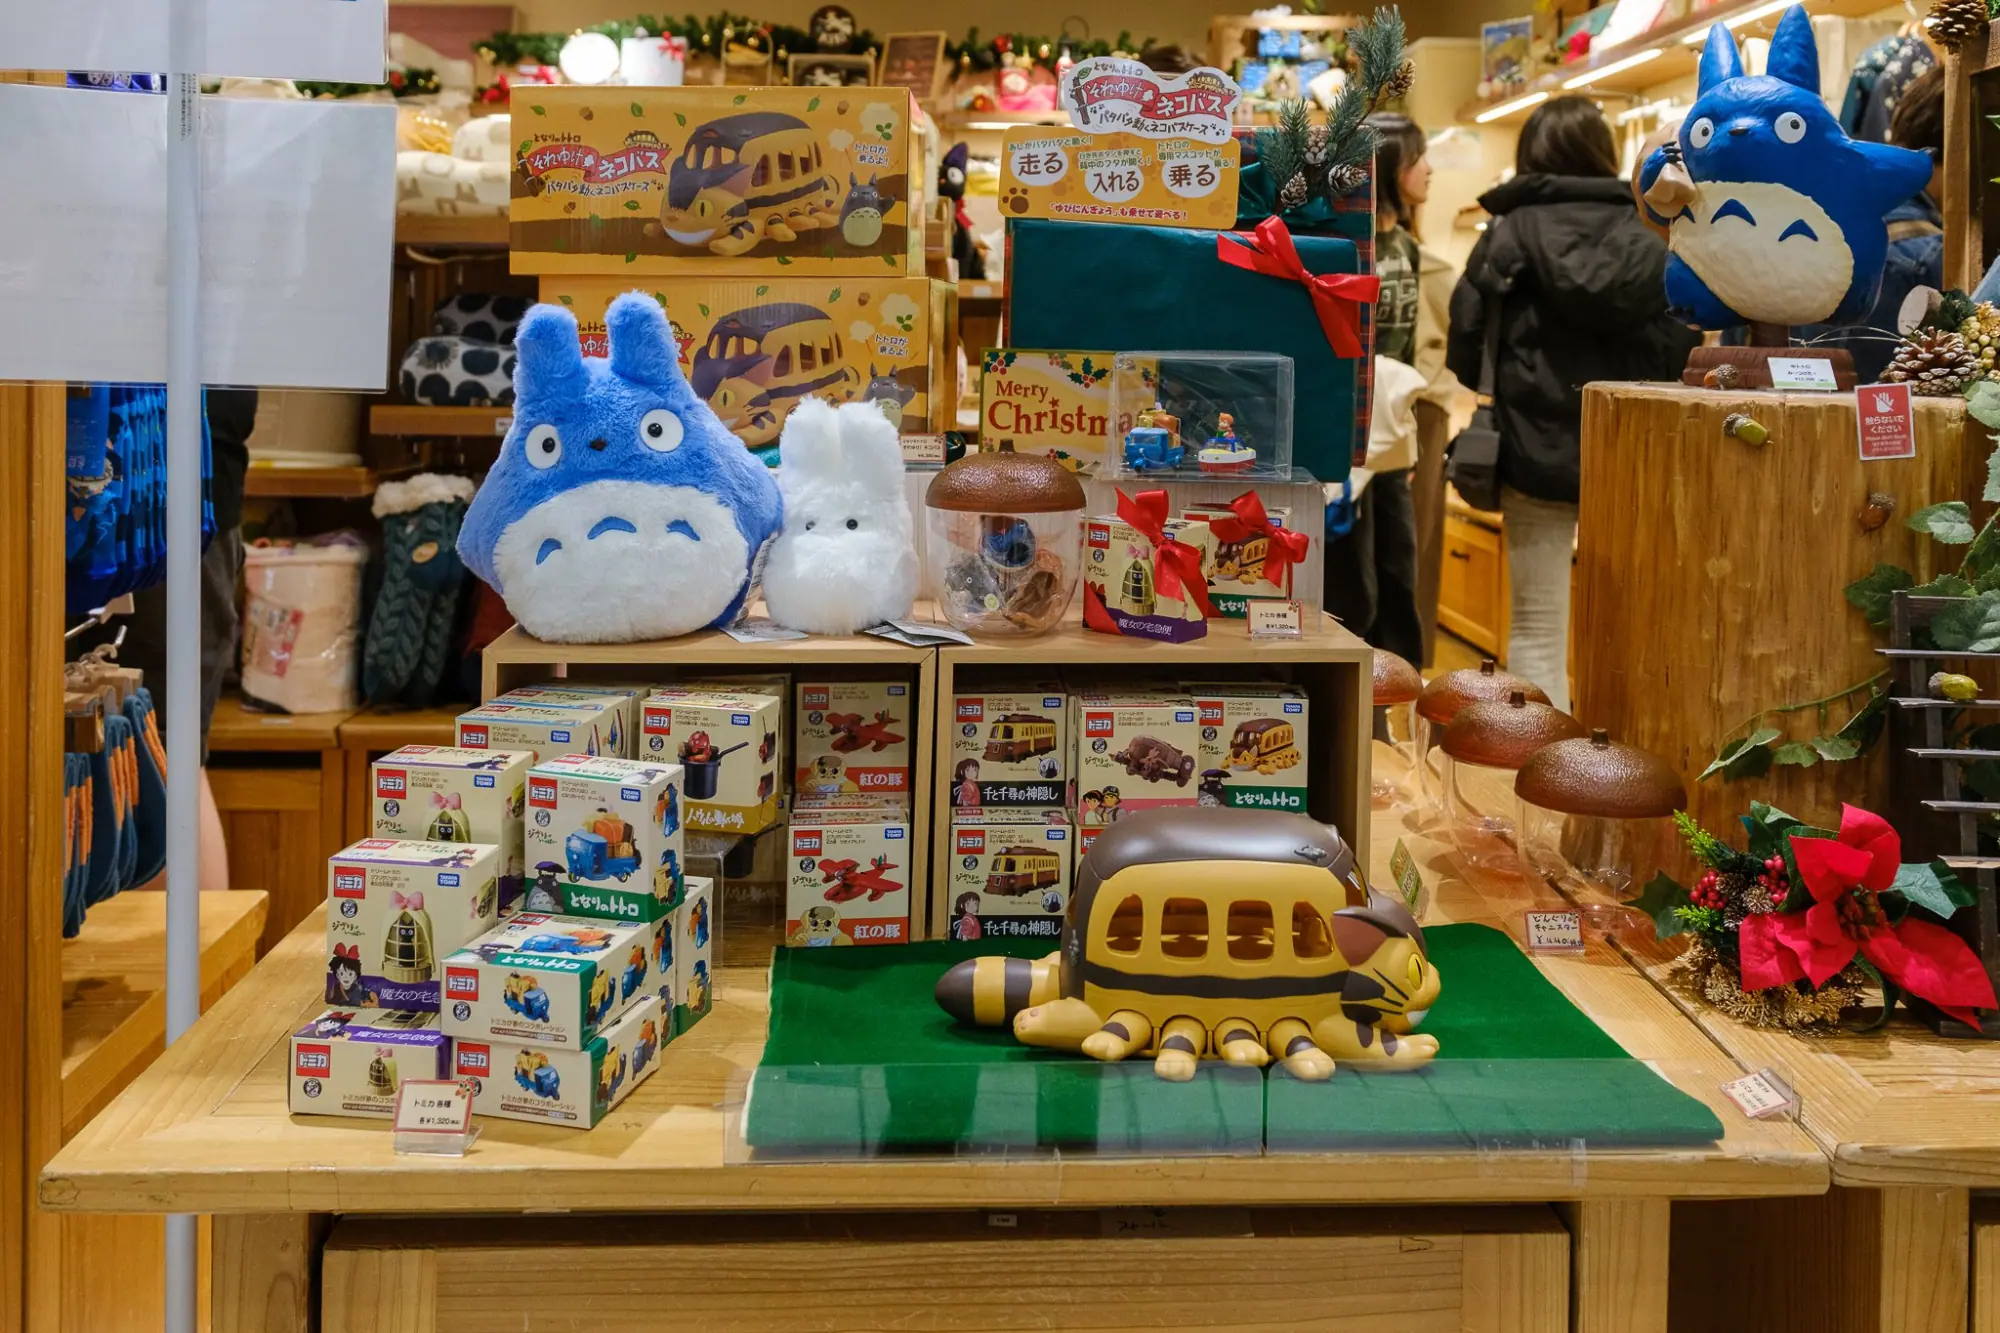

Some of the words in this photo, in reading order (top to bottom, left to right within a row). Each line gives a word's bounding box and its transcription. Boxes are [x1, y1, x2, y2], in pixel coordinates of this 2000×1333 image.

[1094, 61, 1144, 76] となりのトトロ
[1157, 92, 1223, 117] ネコバス
[599, 150, 659, 179] ネコバス
[1018, 152, 1063, 177] 走る
[1092, 170, 1140, 194] 入れる
[1168, 164, 1216, 188] 乗る
[995, 380, 1049, 403] Merry
[988, 399, 1133, 436] Christma
[805, 693, 826, 703] トミカ
[959, 705, 981, 715] トミカ
[646, 715, 669, 728] トミカ
[1087, 719, 1112, 731] トミカ
[463, 732, 487, 745] トミカ
[379, 776, 404, 791] トミカ
[859, 772, 903, 786] 紅の豚
[531, 786, 555, 800] トミカ
[983, 786, 1058, 800] 千と千尋の神隠し
[1235, 791, 1300, 806] となりのトトロ
[796, 837, 819, 849] トミカ
[959, 836, 983, 848] トミカ
[336, 874, 364, 889] トミカ
[571, 892, 639, 916] となりのトトロ
[1533, 914, 1567, 923] どんぐり
[853, 924, 900, 938] 紅の豚
[984, 920, 1061, 935] 千と千尋の神隠し
[501, 955, 581, 970] となりのトトロ
[448, 976, 476, 991] トミカ
[299, 1052, 329, 1068] トミカ
[459, 1051, 487, 1067] トミカ
